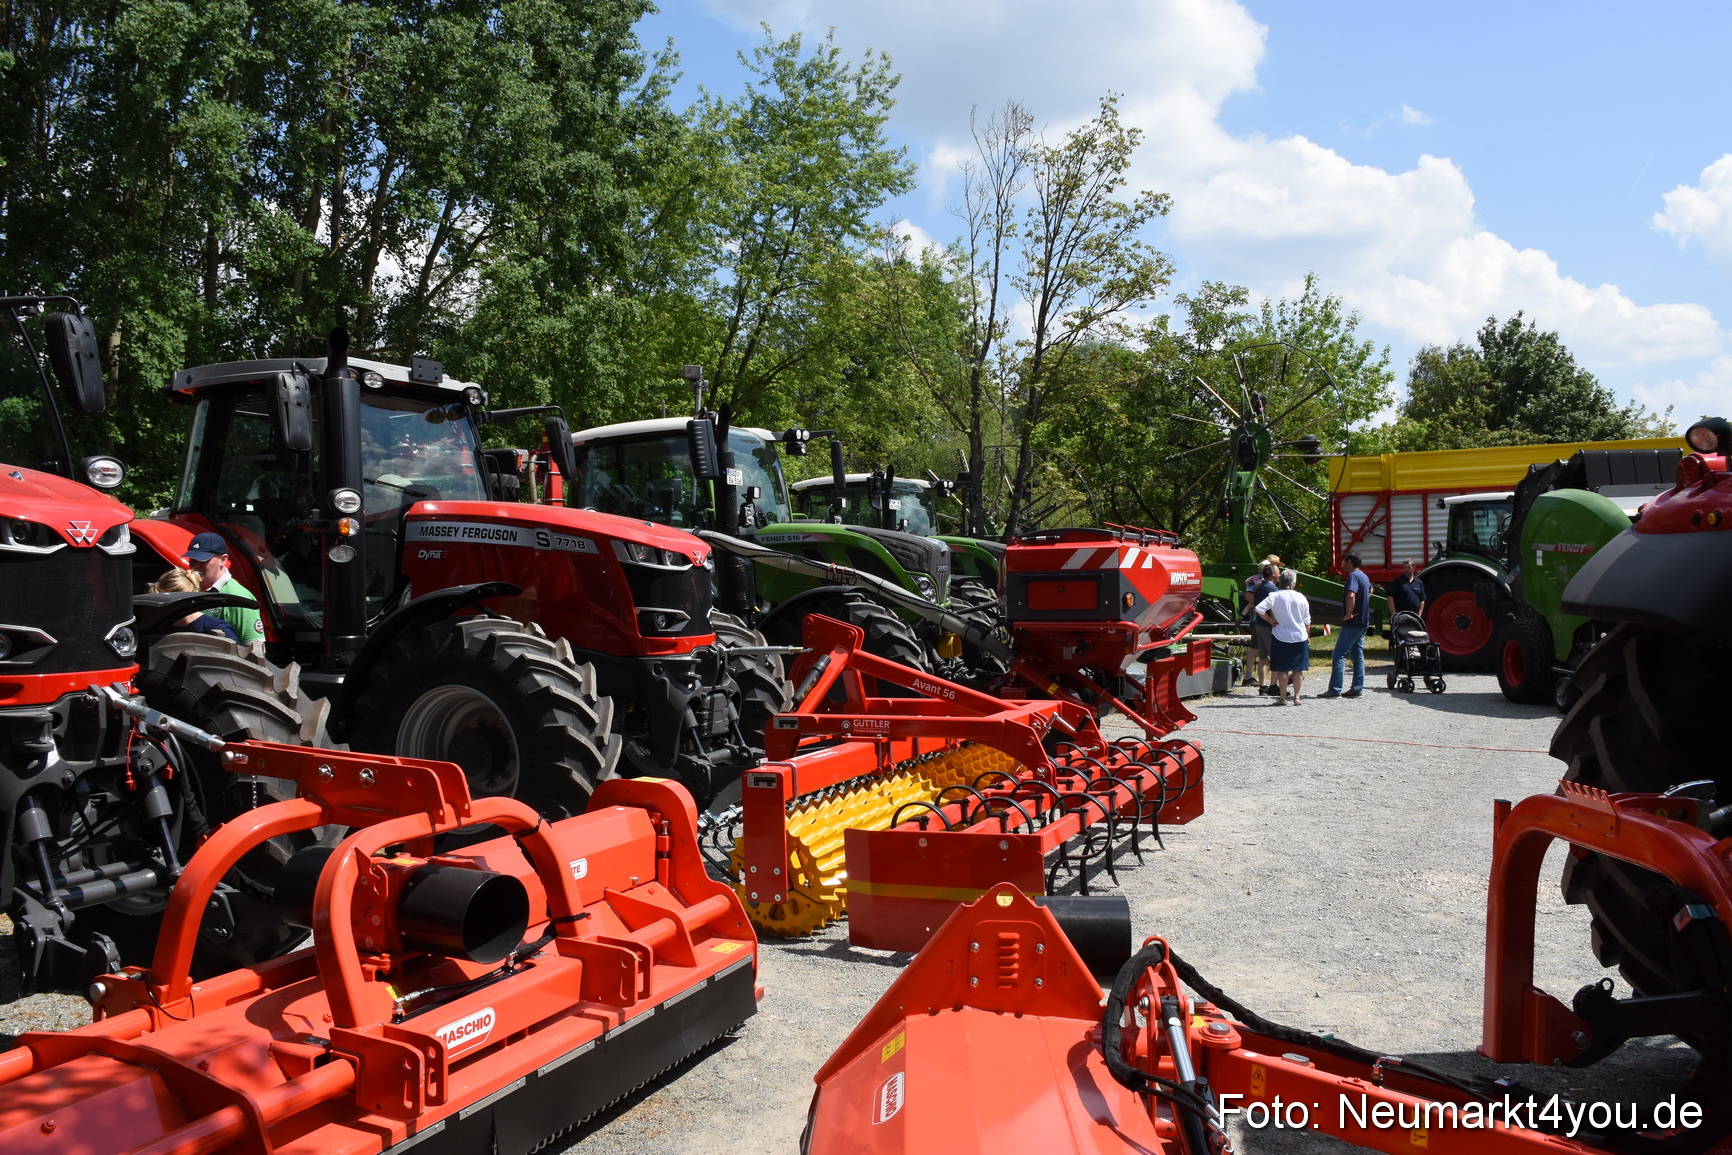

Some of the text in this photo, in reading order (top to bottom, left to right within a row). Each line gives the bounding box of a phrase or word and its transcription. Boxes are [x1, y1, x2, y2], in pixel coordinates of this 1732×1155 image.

[419, 526, 586, 549] MASSEY FERGUSON S 7718
[1557, 542, 1587, 553] FENDT
[912, 678, 956, 700] Avant 56
[853, 718, 890, 728] GÜTTLER
[885, 1076, 898, 1118] MASCHIO
